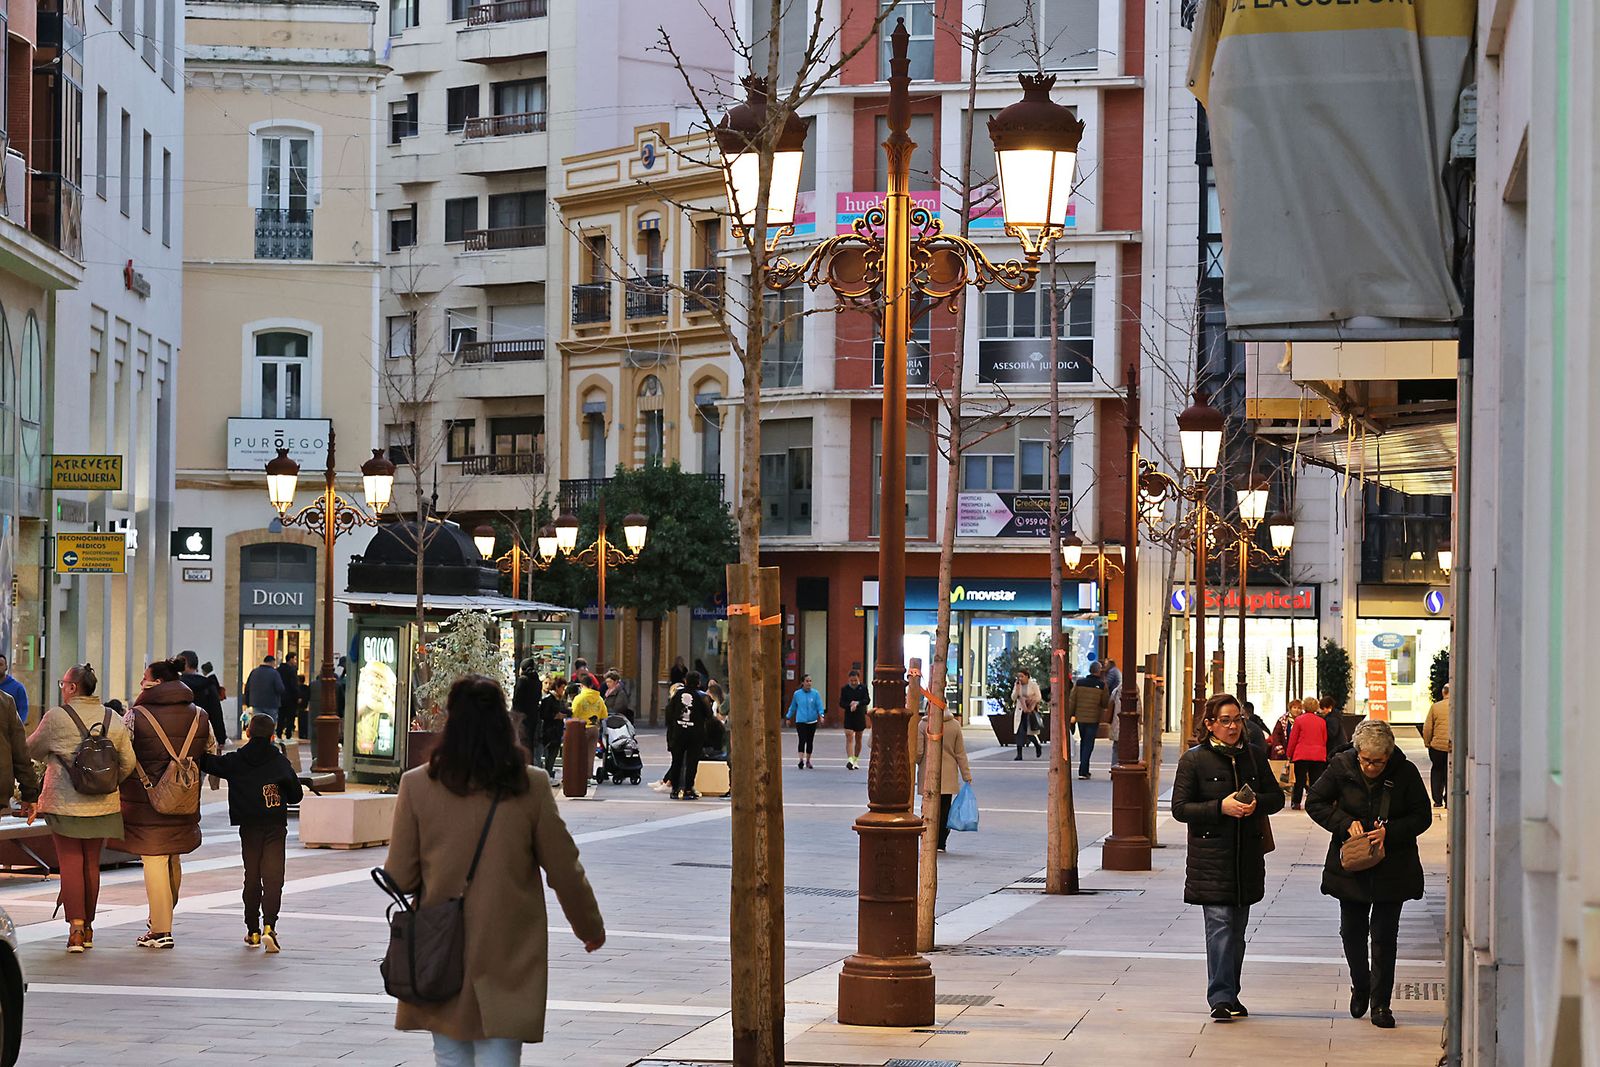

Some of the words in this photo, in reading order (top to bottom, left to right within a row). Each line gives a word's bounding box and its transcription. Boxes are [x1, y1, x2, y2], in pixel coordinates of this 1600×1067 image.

[993, 361, 1035, 370] ASESORÍA
[1039, 361, 1080, 371] JUDICA
[966, 590, 1017, 601] movistar
[363, 636, 395, 663] GOIKO
